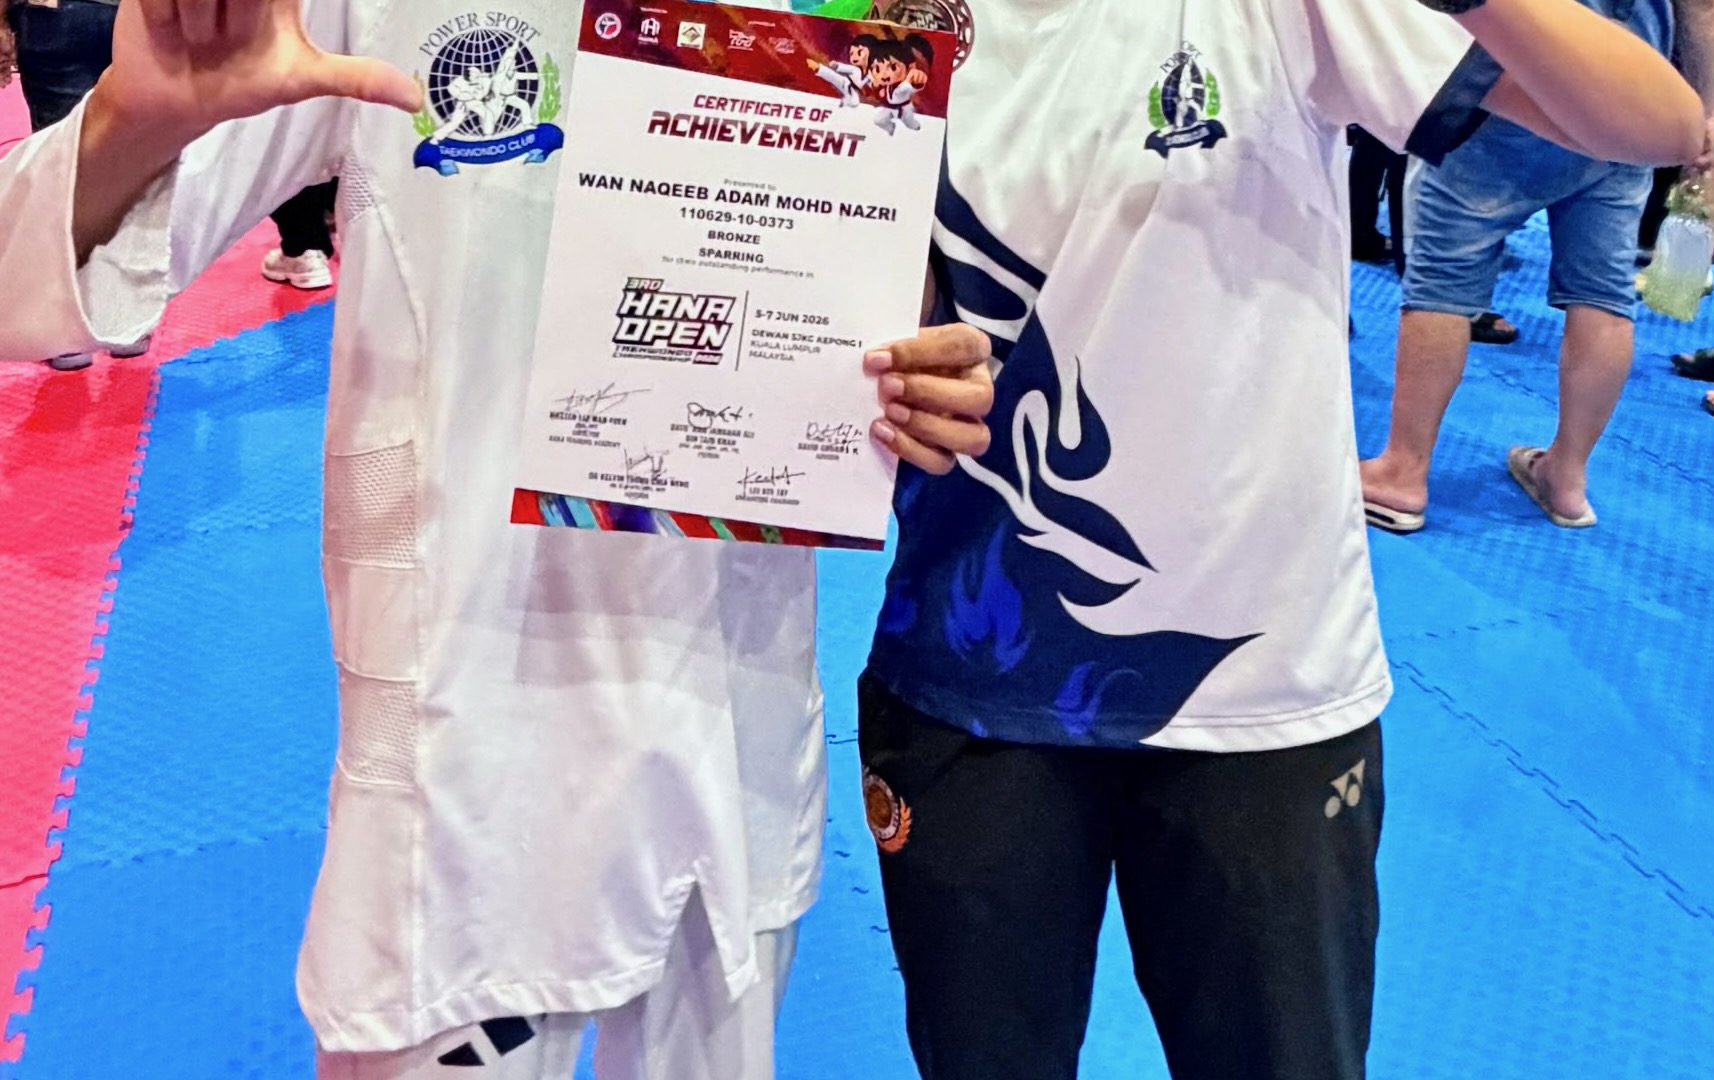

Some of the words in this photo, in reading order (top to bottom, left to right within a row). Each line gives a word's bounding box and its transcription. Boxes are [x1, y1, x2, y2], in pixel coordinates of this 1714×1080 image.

[419, 11, 479, 56] POWER
[485, 11, 541, 43] SPORT
[693, 94, 806, 120] CERTIFICATE
[808, 108, 833, 123] OF
[507, 133, 536, 151] CLUB
[647, 110, 867, 157] ACHIEVEMENT
[723, 178, 766, 190] Presented
[767, 183, 777, 191] to
[578, 172, 623, 191] WAN
[629, 178, 709, 200] NAQEEB
[714, 188, 770, 208] ADAM
[776, 195, 833, 214] MOHD
[839, 202, 897, 222] NAZRI
[679, 207, 795, 230] 110629-10-0373
[707, 230, 761, 245] BRONZE
[698, 247, 765, 264] SPARRING
[698, 259, 749, 272] outstanding
[751, 265, 804, 278] performance
[626, 278, 663, 290] 3RD
[617, 291, 736, 321] HANA
[755, 309, 774, 320] 5-7
[775, 311, 799, 322] JUN
[801, 314, 830, 326] 2026
[613, 317, 732, 350] OPEN
[751, 329, 789, 340] DEWAN
[816, 336, 856, 348] KEPONG
[749, 350, 795, 362] MALAYSIA
[750, 340, 781, 350] KUALA
[782, 343, 821, 354] LUMPUR
